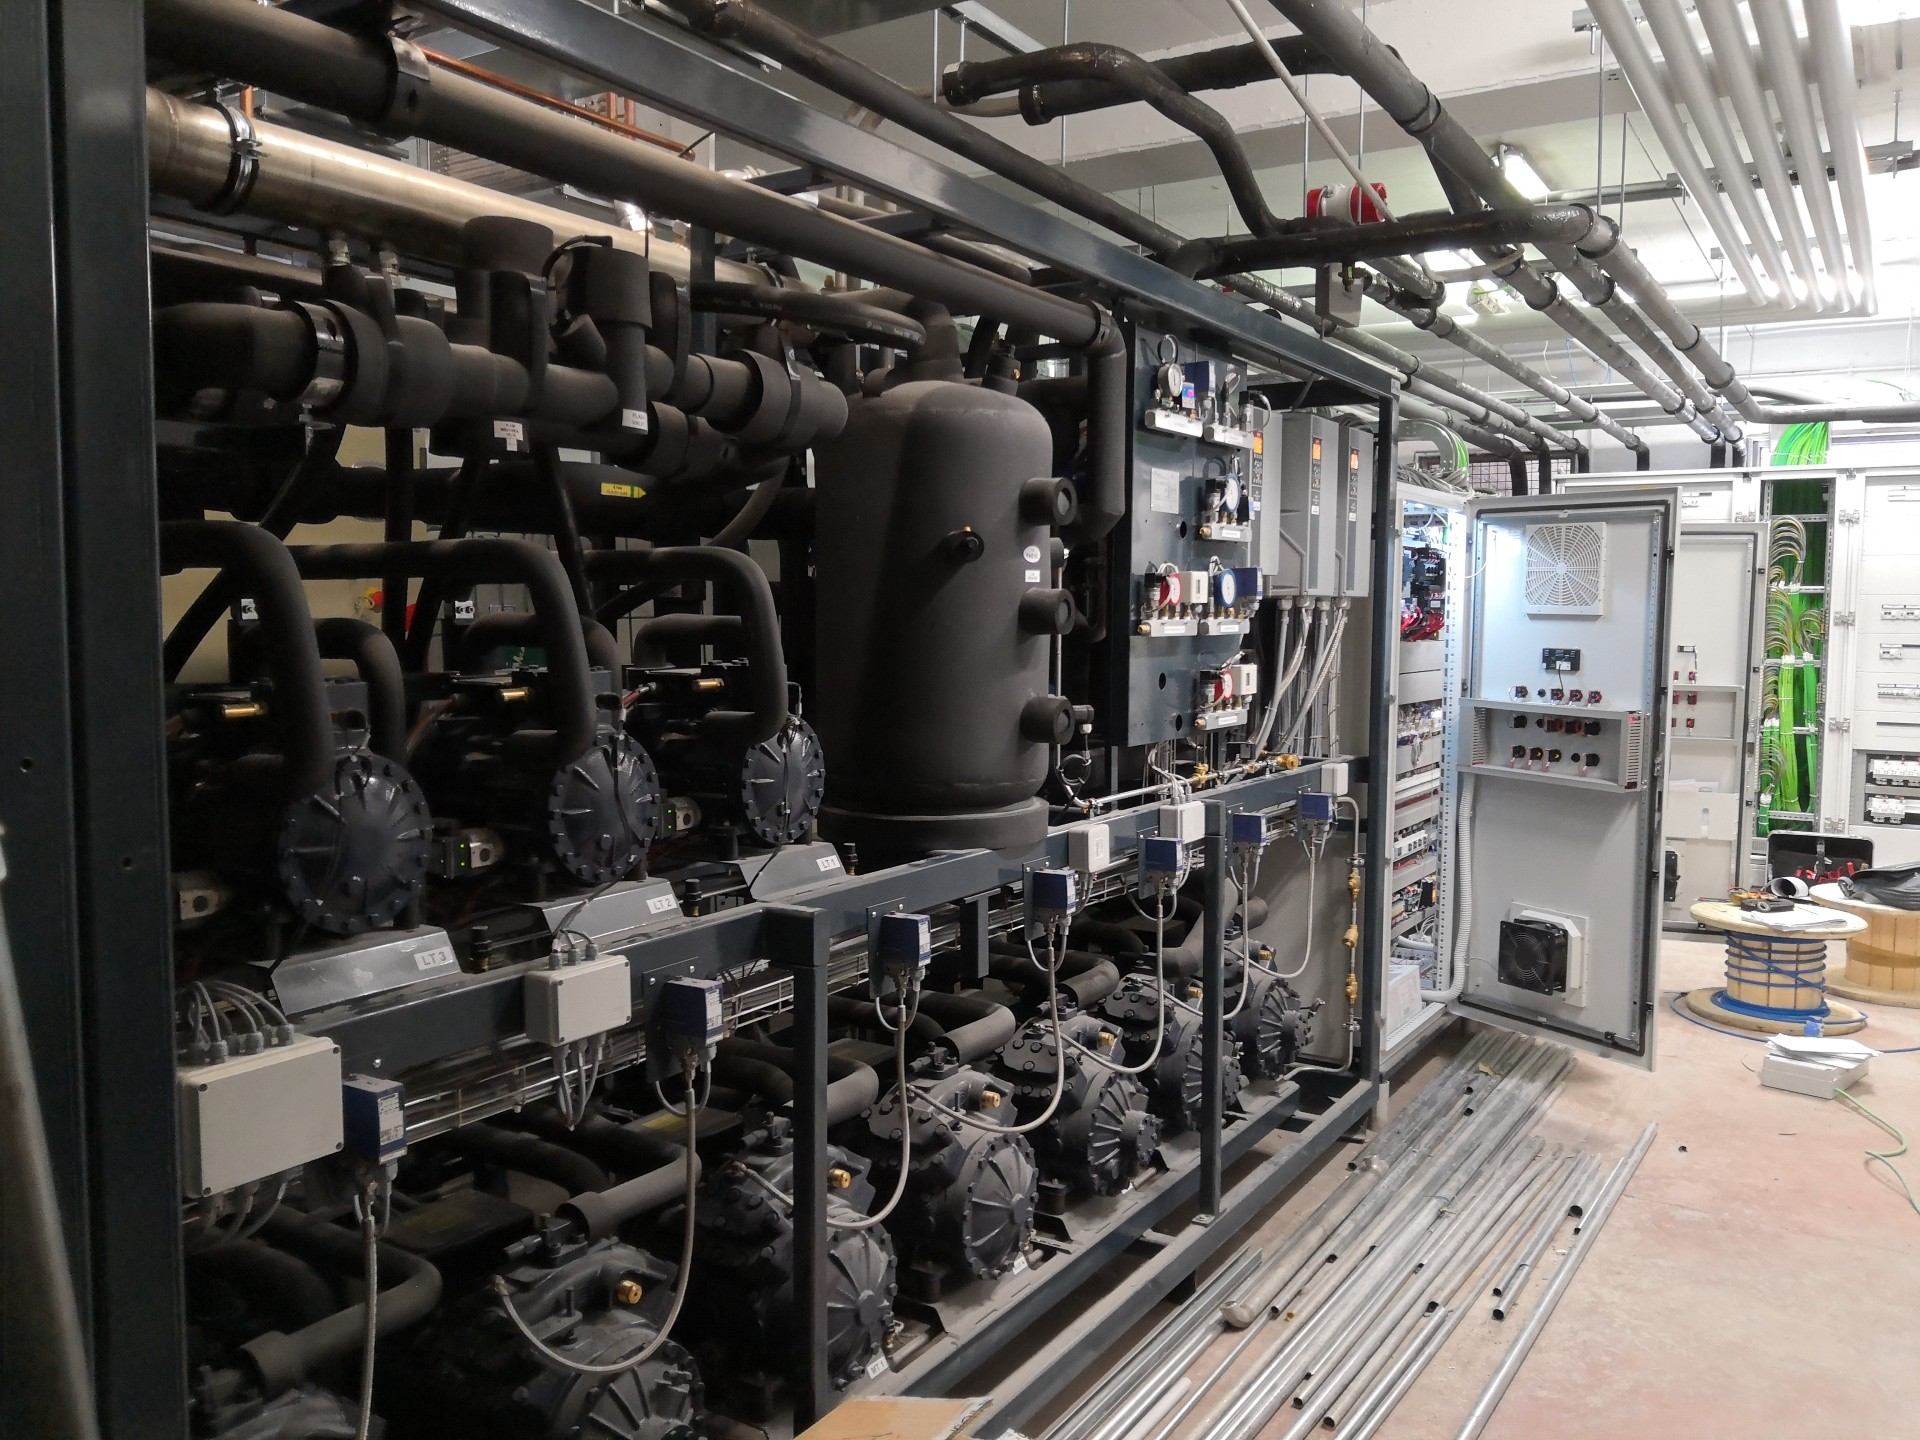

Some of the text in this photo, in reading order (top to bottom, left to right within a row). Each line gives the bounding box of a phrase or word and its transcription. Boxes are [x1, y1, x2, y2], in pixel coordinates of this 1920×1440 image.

[822, 859, 831, 869] LT
[653, 898, 672, 910] LT 2
[422, 951, 447, 965] LT 3
